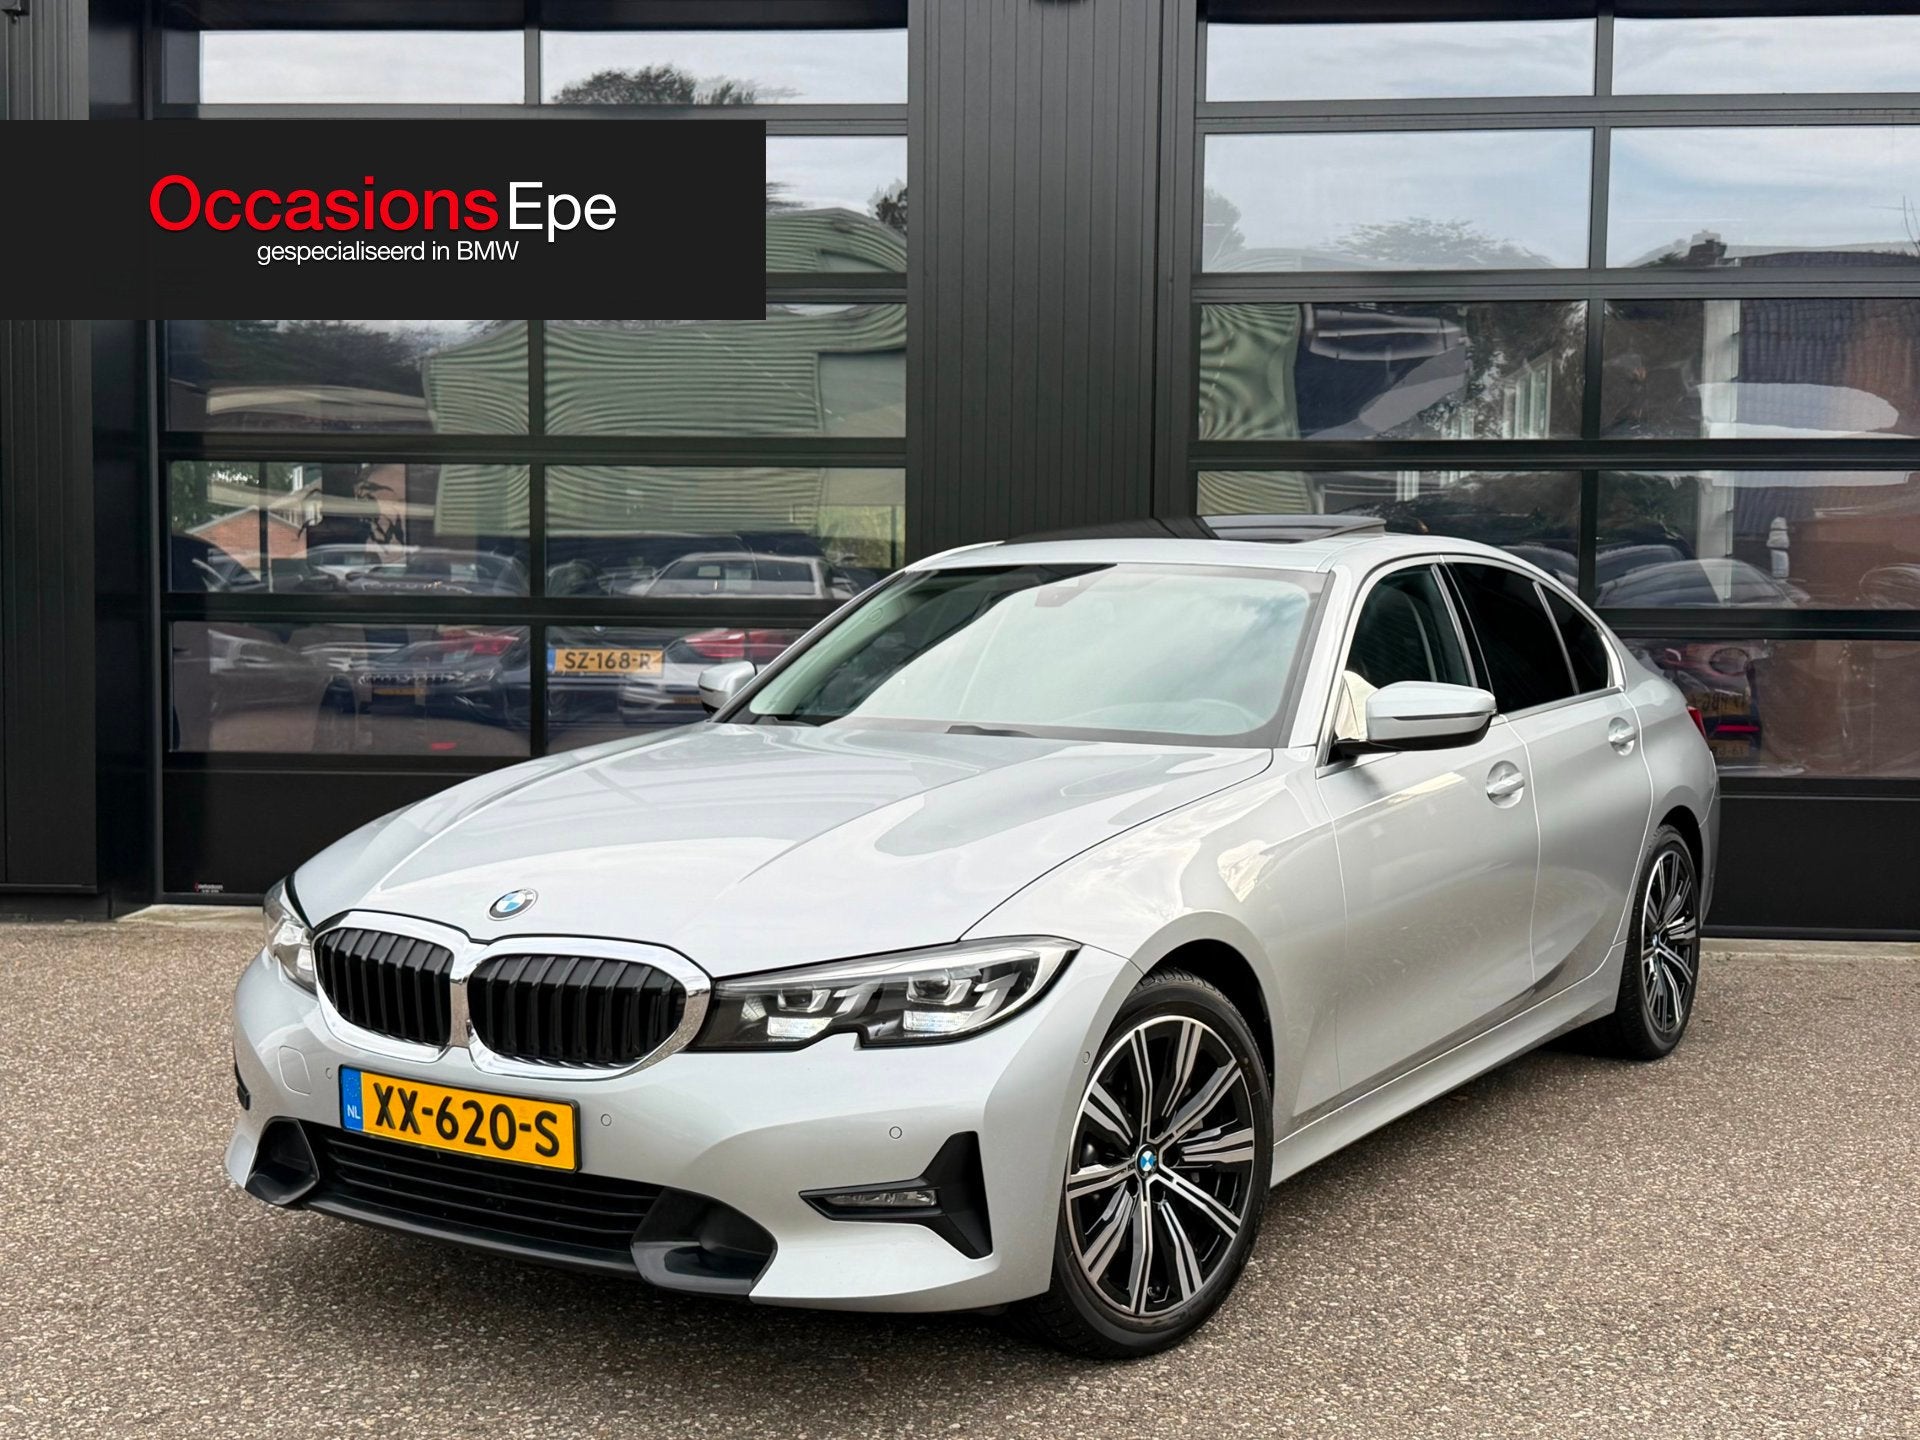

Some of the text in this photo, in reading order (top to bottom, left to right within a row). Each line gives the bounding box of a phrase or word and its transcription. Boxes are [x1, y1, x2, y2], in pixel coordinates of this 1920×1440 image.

[564, 651, 652, 670] SZ-168-R
[347, 1106, 361, 1120] NL
[373, 1082, 560, 1158] XX-620-S
